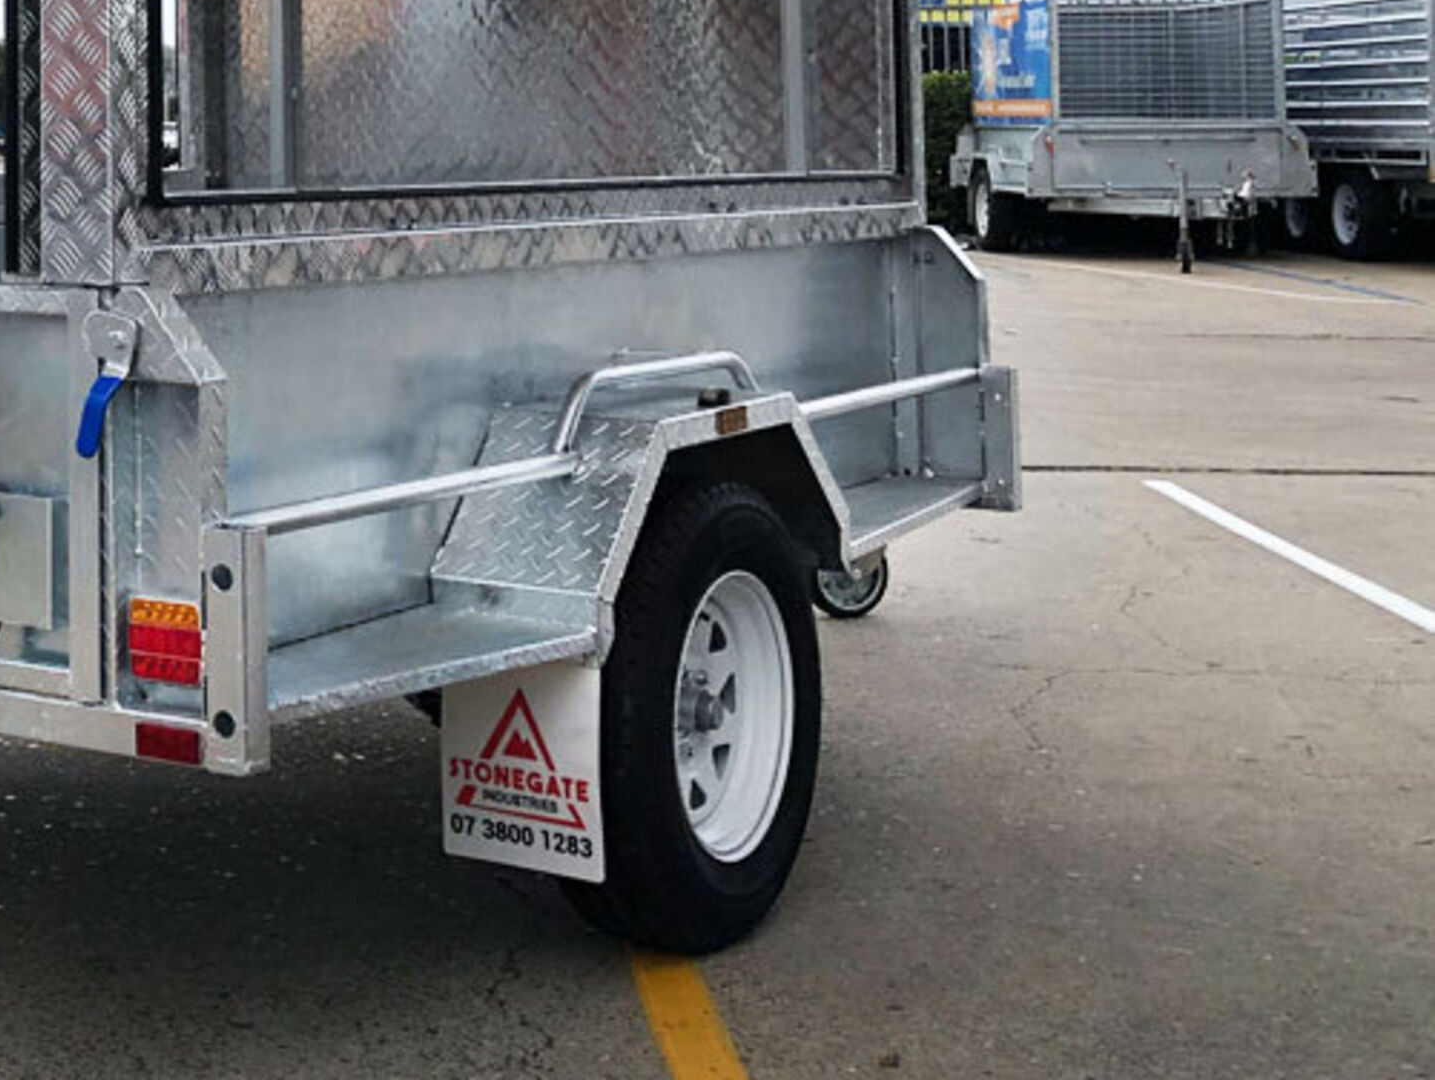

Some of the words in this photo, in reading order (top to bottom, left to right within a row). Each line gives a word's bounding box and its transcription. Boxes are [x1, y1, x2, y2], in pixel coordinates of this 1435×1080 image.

[449, 757, 589, 802] STONEGATE
[481, 788, 558, 813] INDUSTRIES
[450, 812, 476, 834] 07
[482, 818, 535, 847] 3800
[541, 830, 593, 858] 1283
